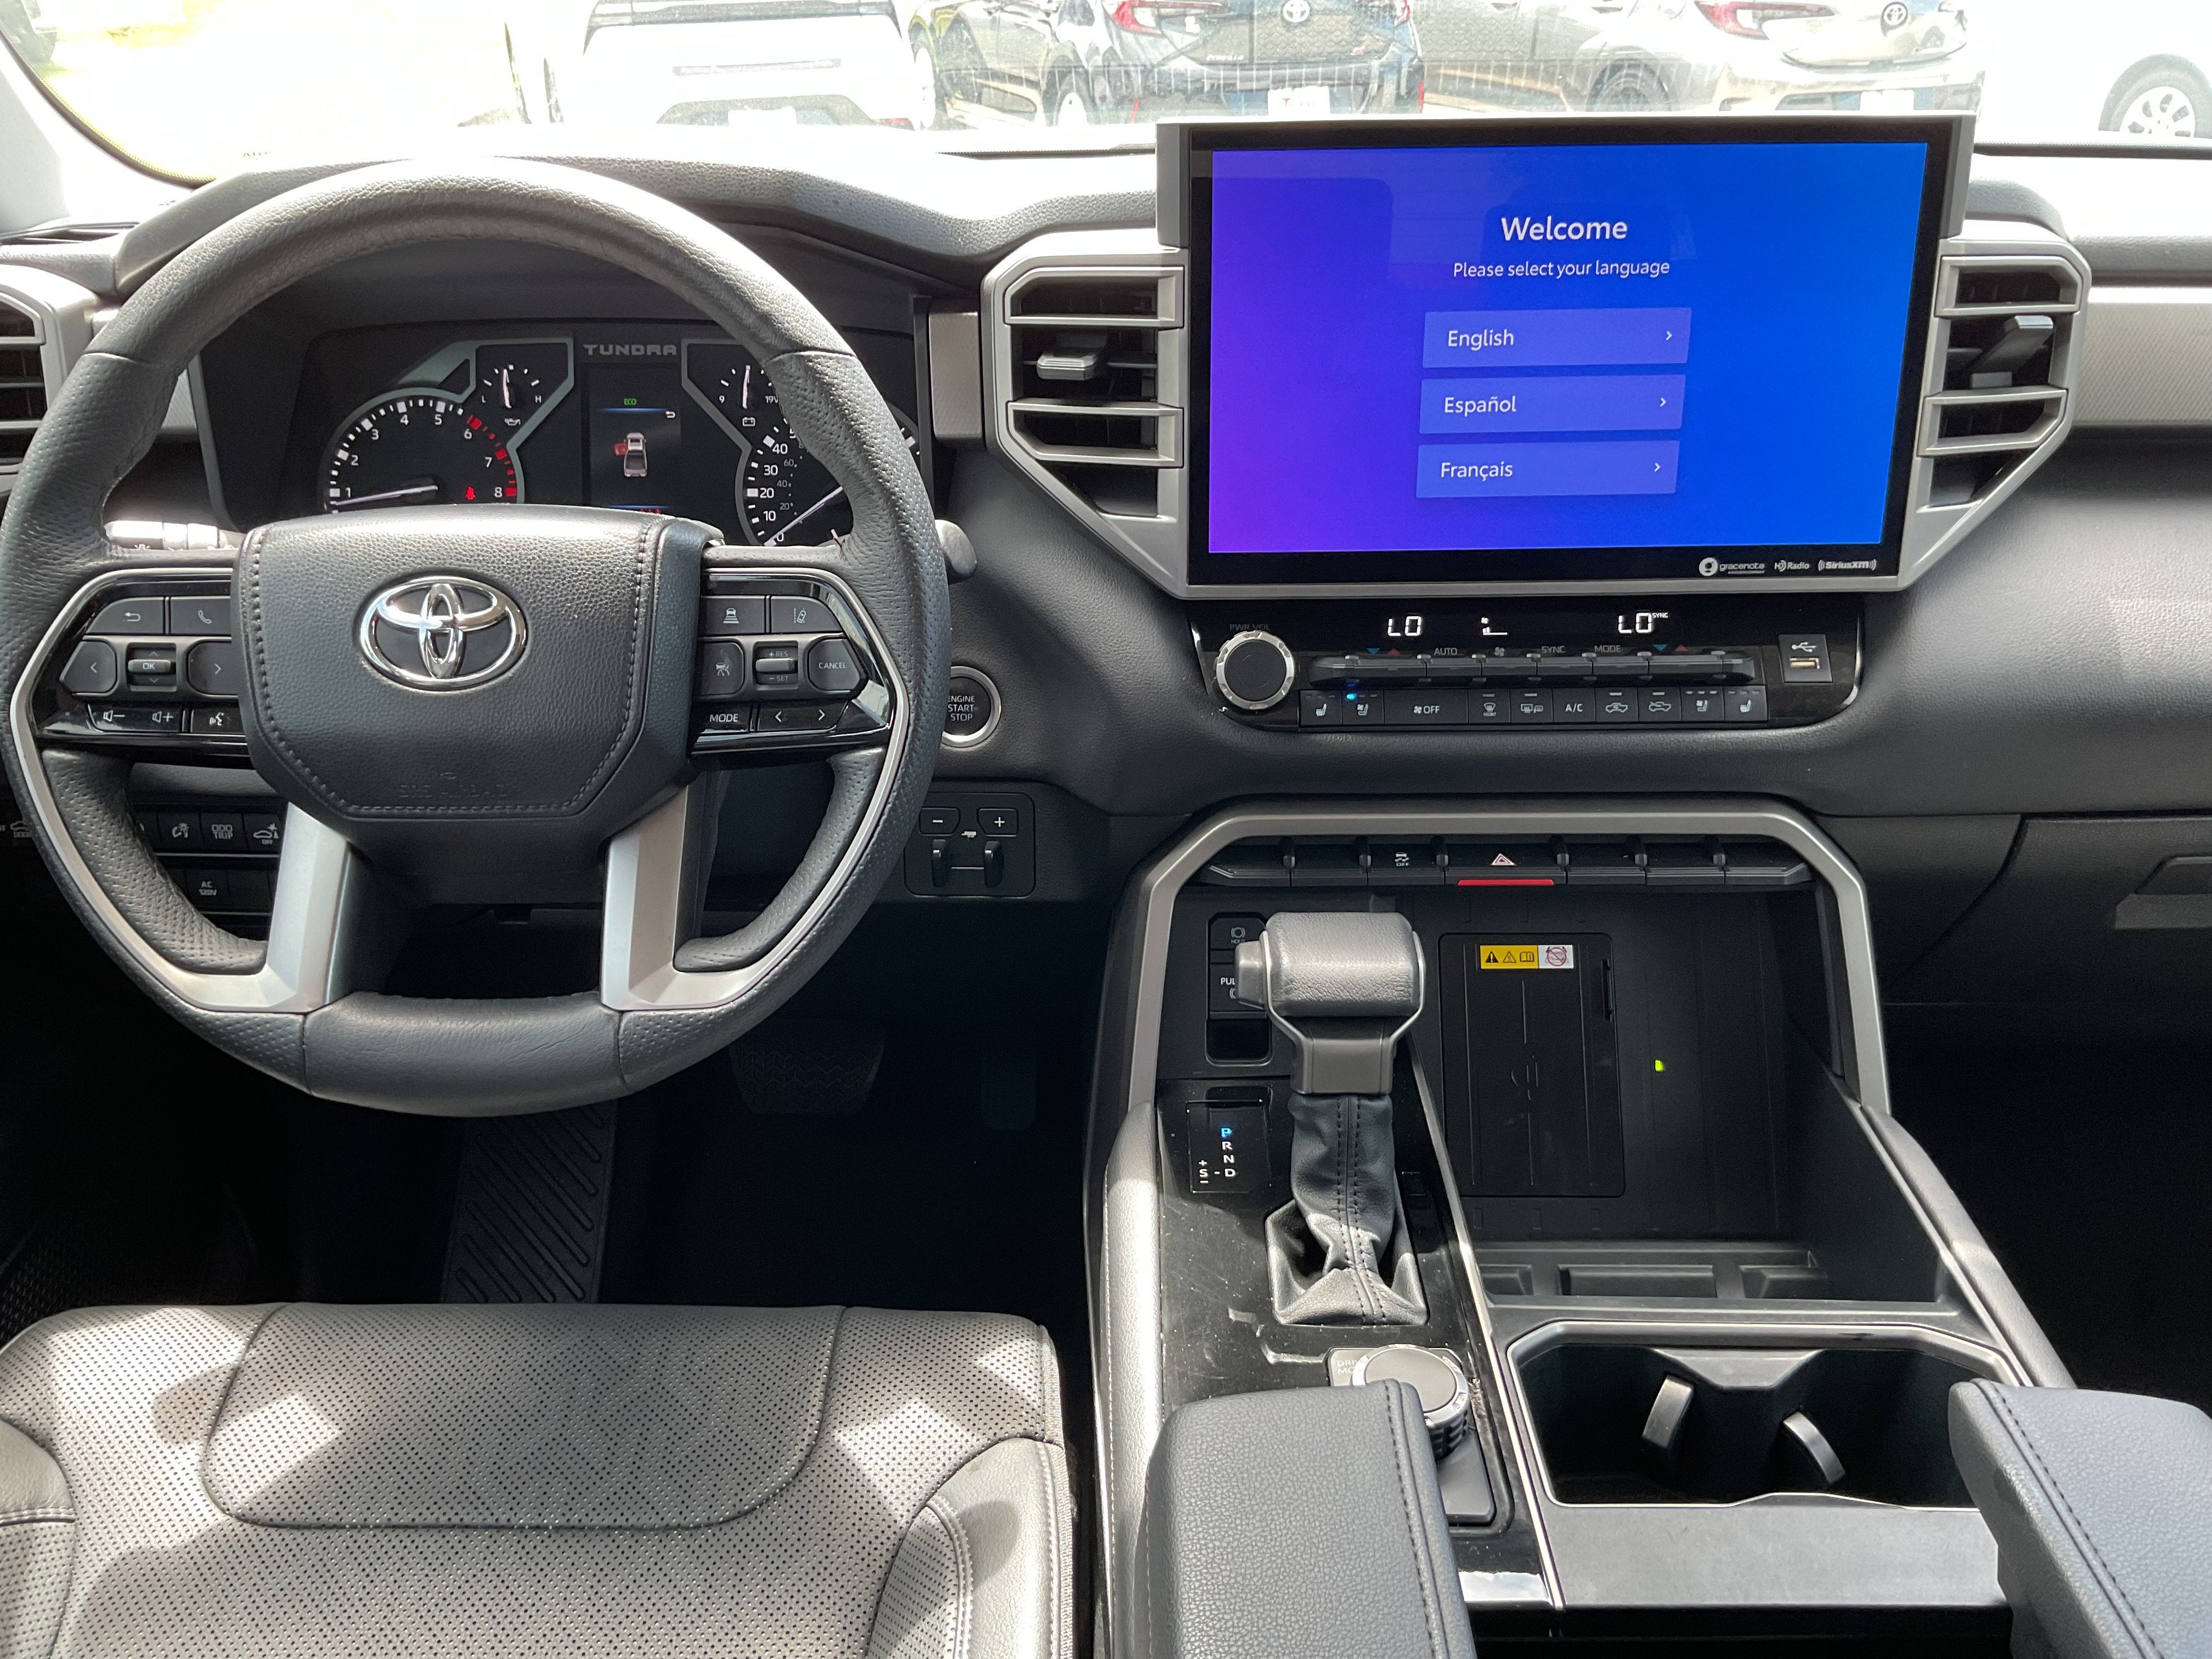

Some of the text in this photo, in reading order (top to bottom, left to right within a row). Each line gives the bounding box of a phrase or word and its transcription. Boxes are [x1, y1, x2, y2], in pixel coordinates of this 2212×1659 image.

[1501, 216, 1628, 241] Welcome
[1453, 260, 1670, 279] Please select your language
[1448, 329, 1514, 351] English
[583, 344, 676, 356] TUNDRA
[481, 395, 486, 403] L
[534, 394, 541, 403] H
[719, 395, 725, 403] 9
[1444, 395, 1517, 417] Español
[400, 415, 409, 425] 4
[435, 414, 442, 425] 5
[371, 429, 379, 440] 3
[464, 428, 472, 439] 6
[772, 443, 788, 455] 40
[351, 455, 359, 466] 2
[485, 456, 493, 467] 7
[783, 459, 794, 467] 60
[764, 464, 778, 476] 30
[1440, 461, 1513, 482] Français
[776, 479, 788, 488] 40
[346, 487, 352, 498] 1
[494, 487, 503, 498] 8
[759, 487, 775, 499] 20
[780, 502, 791, 511] 20
[763, 510, 777, 522] 10
[776, 532, 785, 542] 0
[1719, 562, 1765, 572] gracenote
[1787, 561, 1810, 570] Radio
[1387, 615, 1422, 637] LO
[1618, 612, 1654, 634] LO
[1434, 647, 1458, 656] AUTO
[1541, 645, 1566, 654] SYNC
[1594, 644, 1622, 653] MODE
[947, 704, 974, 712] START
[1423, 706, 1440, 714] OFF
[1565, 702, 1583, 713] A/C
[709, 713, 738, 723] MODE
[950, 713, 973, 721] STOP
[211, 824, 233, 832] ODO
[212, 831, 233, 839] TRIP
[1220, 977, 1236, 986] PUL
[1221, 1127, 1232, 1137] P
[1222, 1141, 1233, 1150] R
[1223, 1154, 1234, 1163] N
[1224, 1168, 1236, 1177] D
